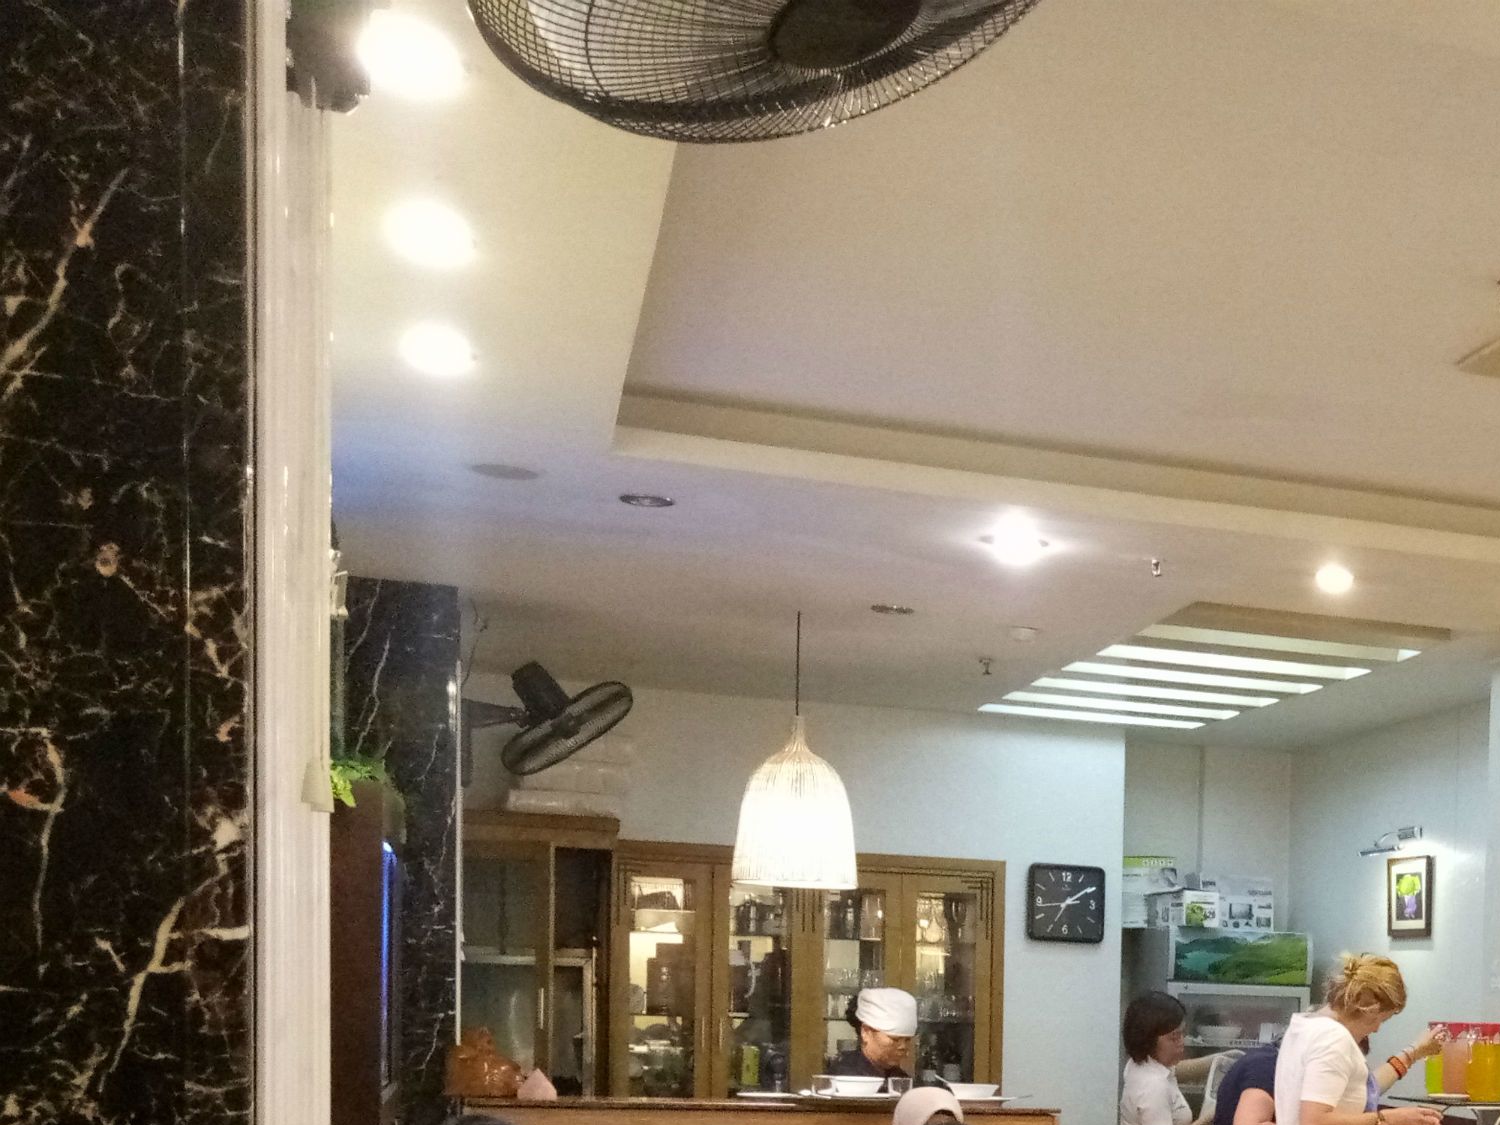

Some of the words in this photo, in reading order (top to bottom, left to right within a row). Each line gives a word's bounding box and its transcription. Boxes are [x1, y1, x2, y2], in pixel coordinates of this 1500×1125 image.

[1061, 872, 1072, 882] 12
[1036, 896, 1042, 907] 9
[1089, 900, 1096, 910] 3
[1062, 924, 1068, 934] 6
